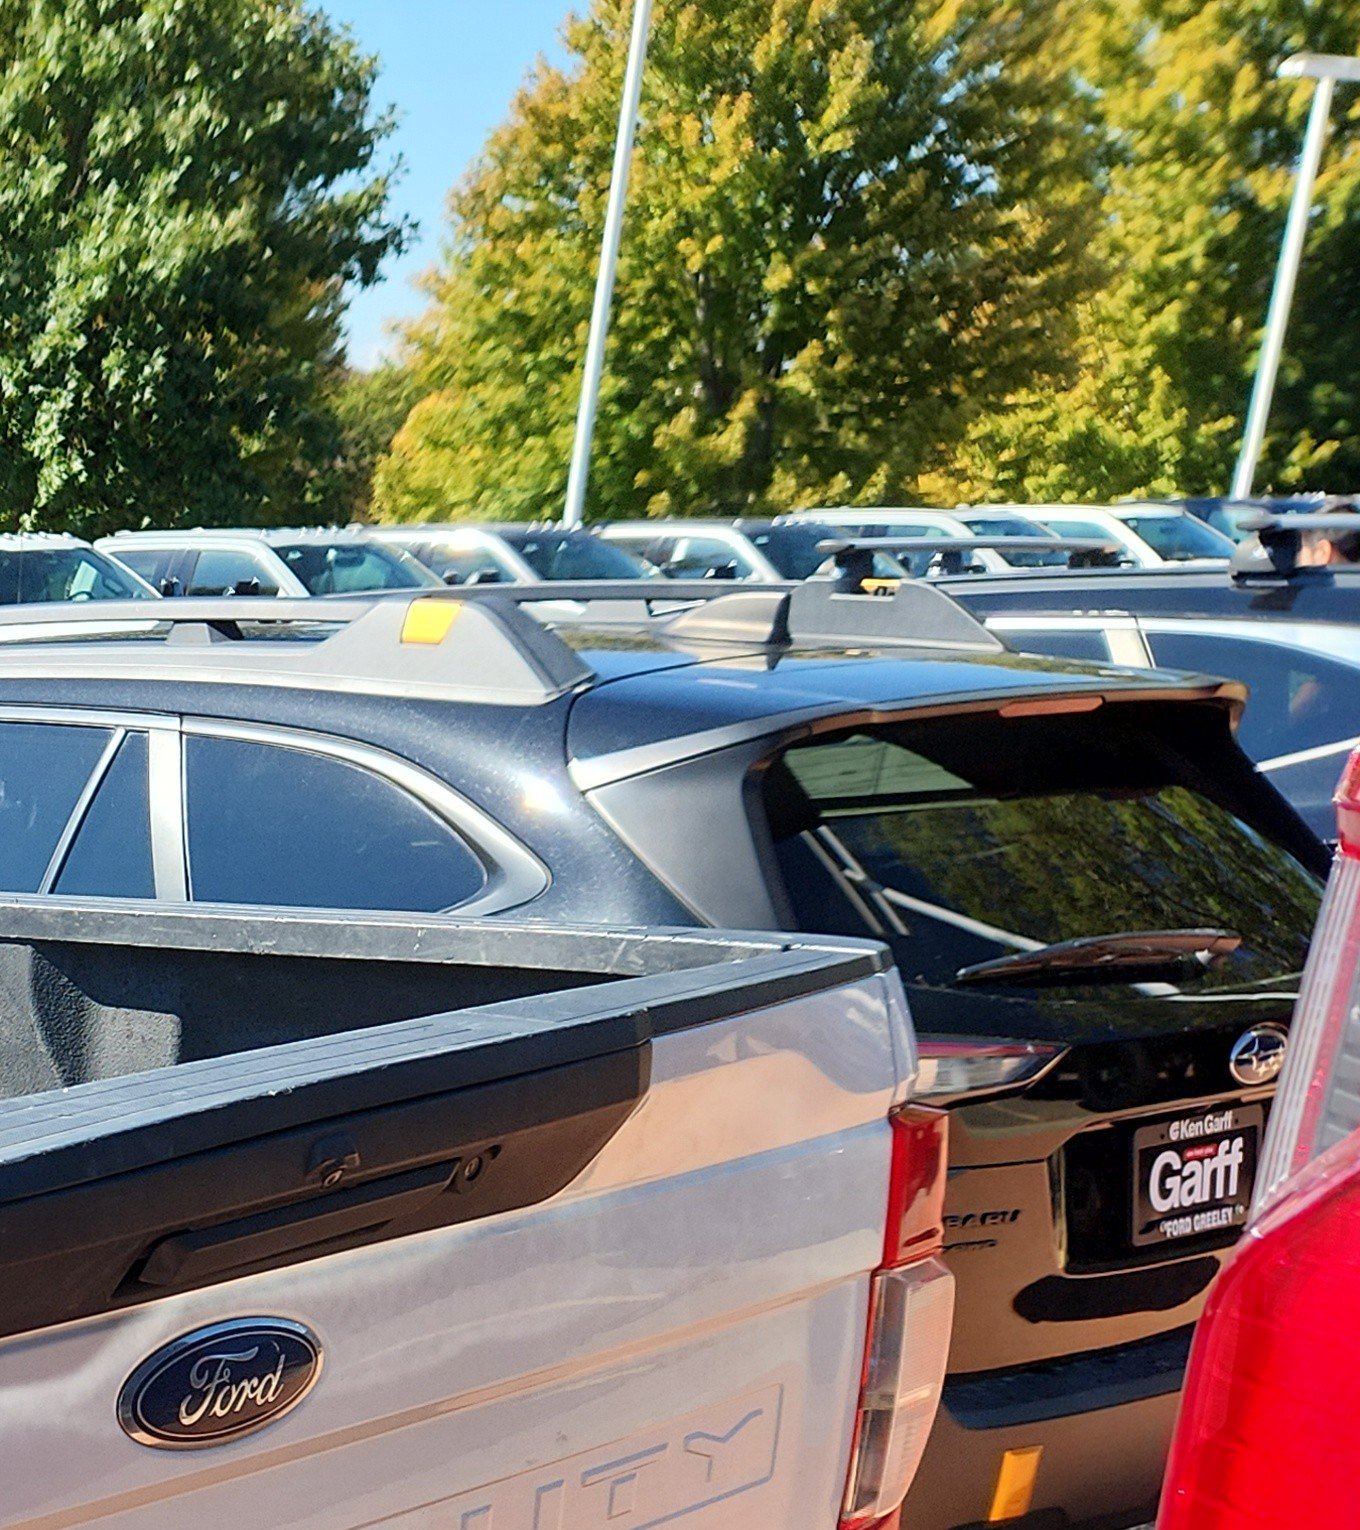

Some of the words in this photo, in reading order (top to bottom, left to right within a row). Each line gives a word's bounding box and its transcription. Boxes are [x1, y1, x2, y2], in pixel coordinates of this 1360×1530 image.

[1180, 1119, 1204, 1140] Ken
[1204, 1110, 1233, 1135] Garff
[1149, 1136, 1244, 1213] Garff
[1166, 1217, 1192, 1238] FORD
[178, 1346, 285, 1426] Ford
